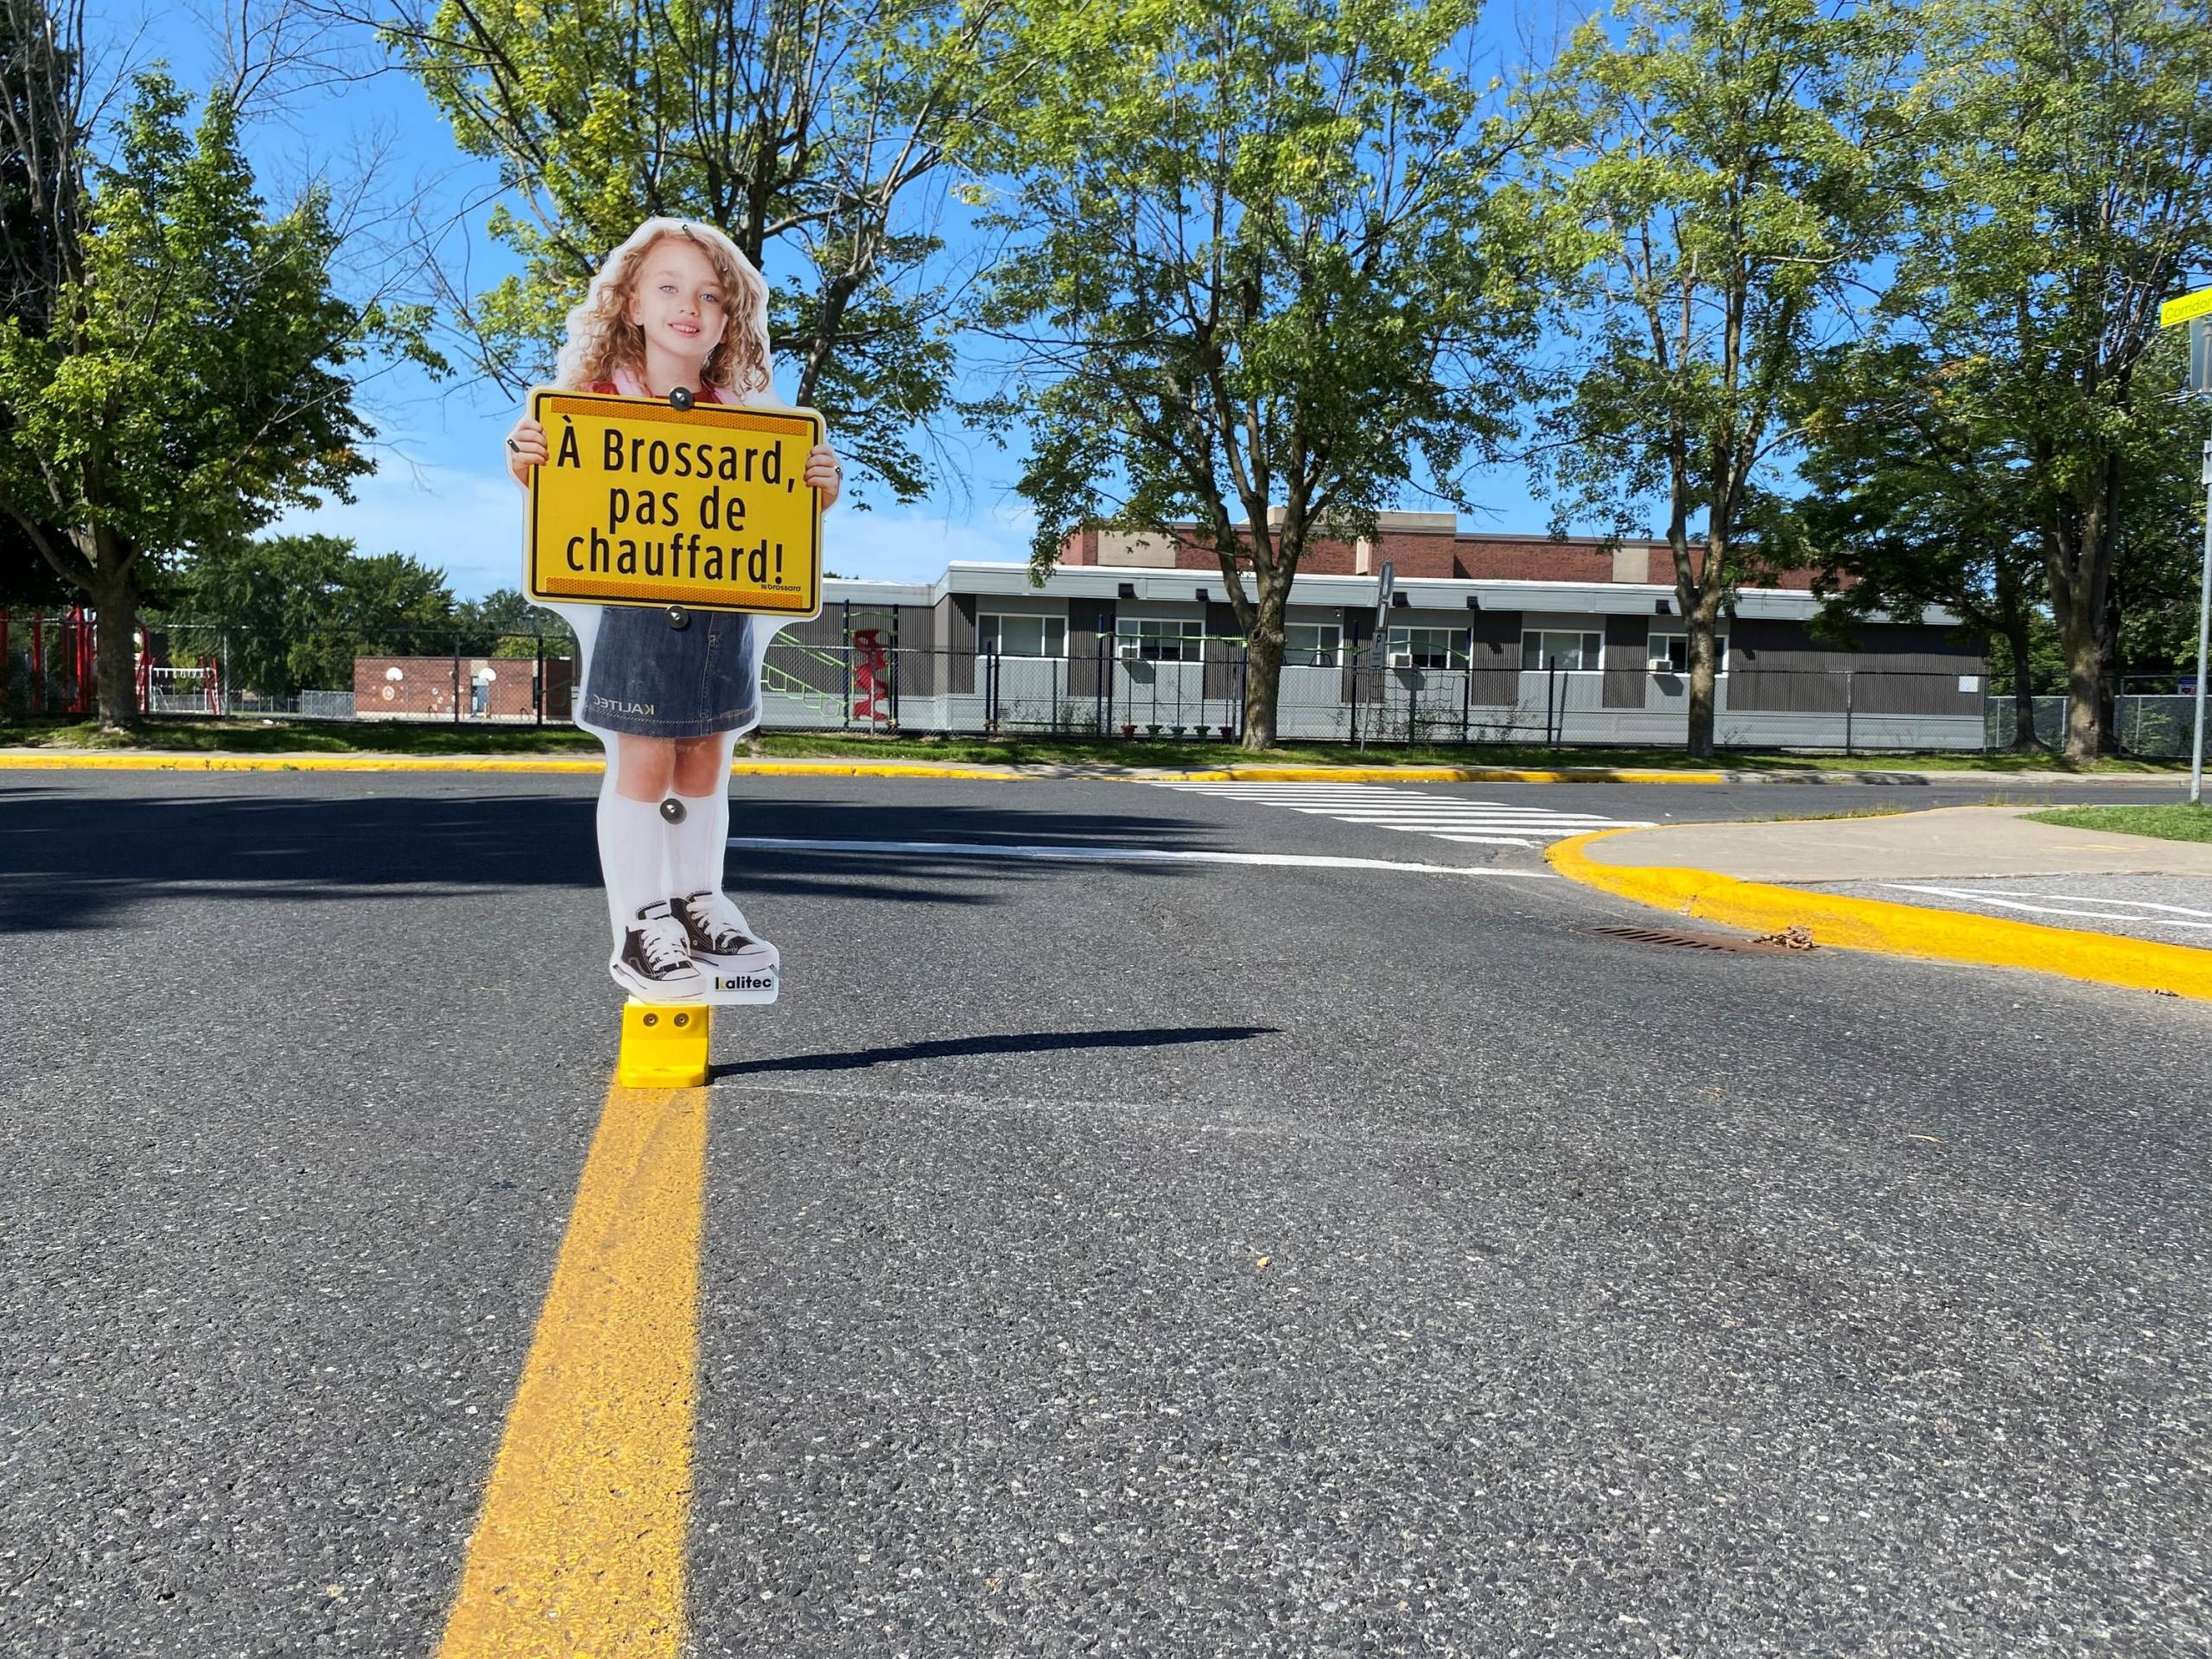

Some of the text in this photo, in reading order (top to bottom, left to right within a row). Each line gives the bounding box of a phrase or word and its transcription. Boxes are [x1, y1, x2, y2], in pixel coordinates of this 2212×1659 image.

[557, 415, 795, 493] À Brossard,
[609, 486, 747, 535] pas de
[567, 527, 783, 585] chauffard!
[715, 976, 772, 989] kalitec
